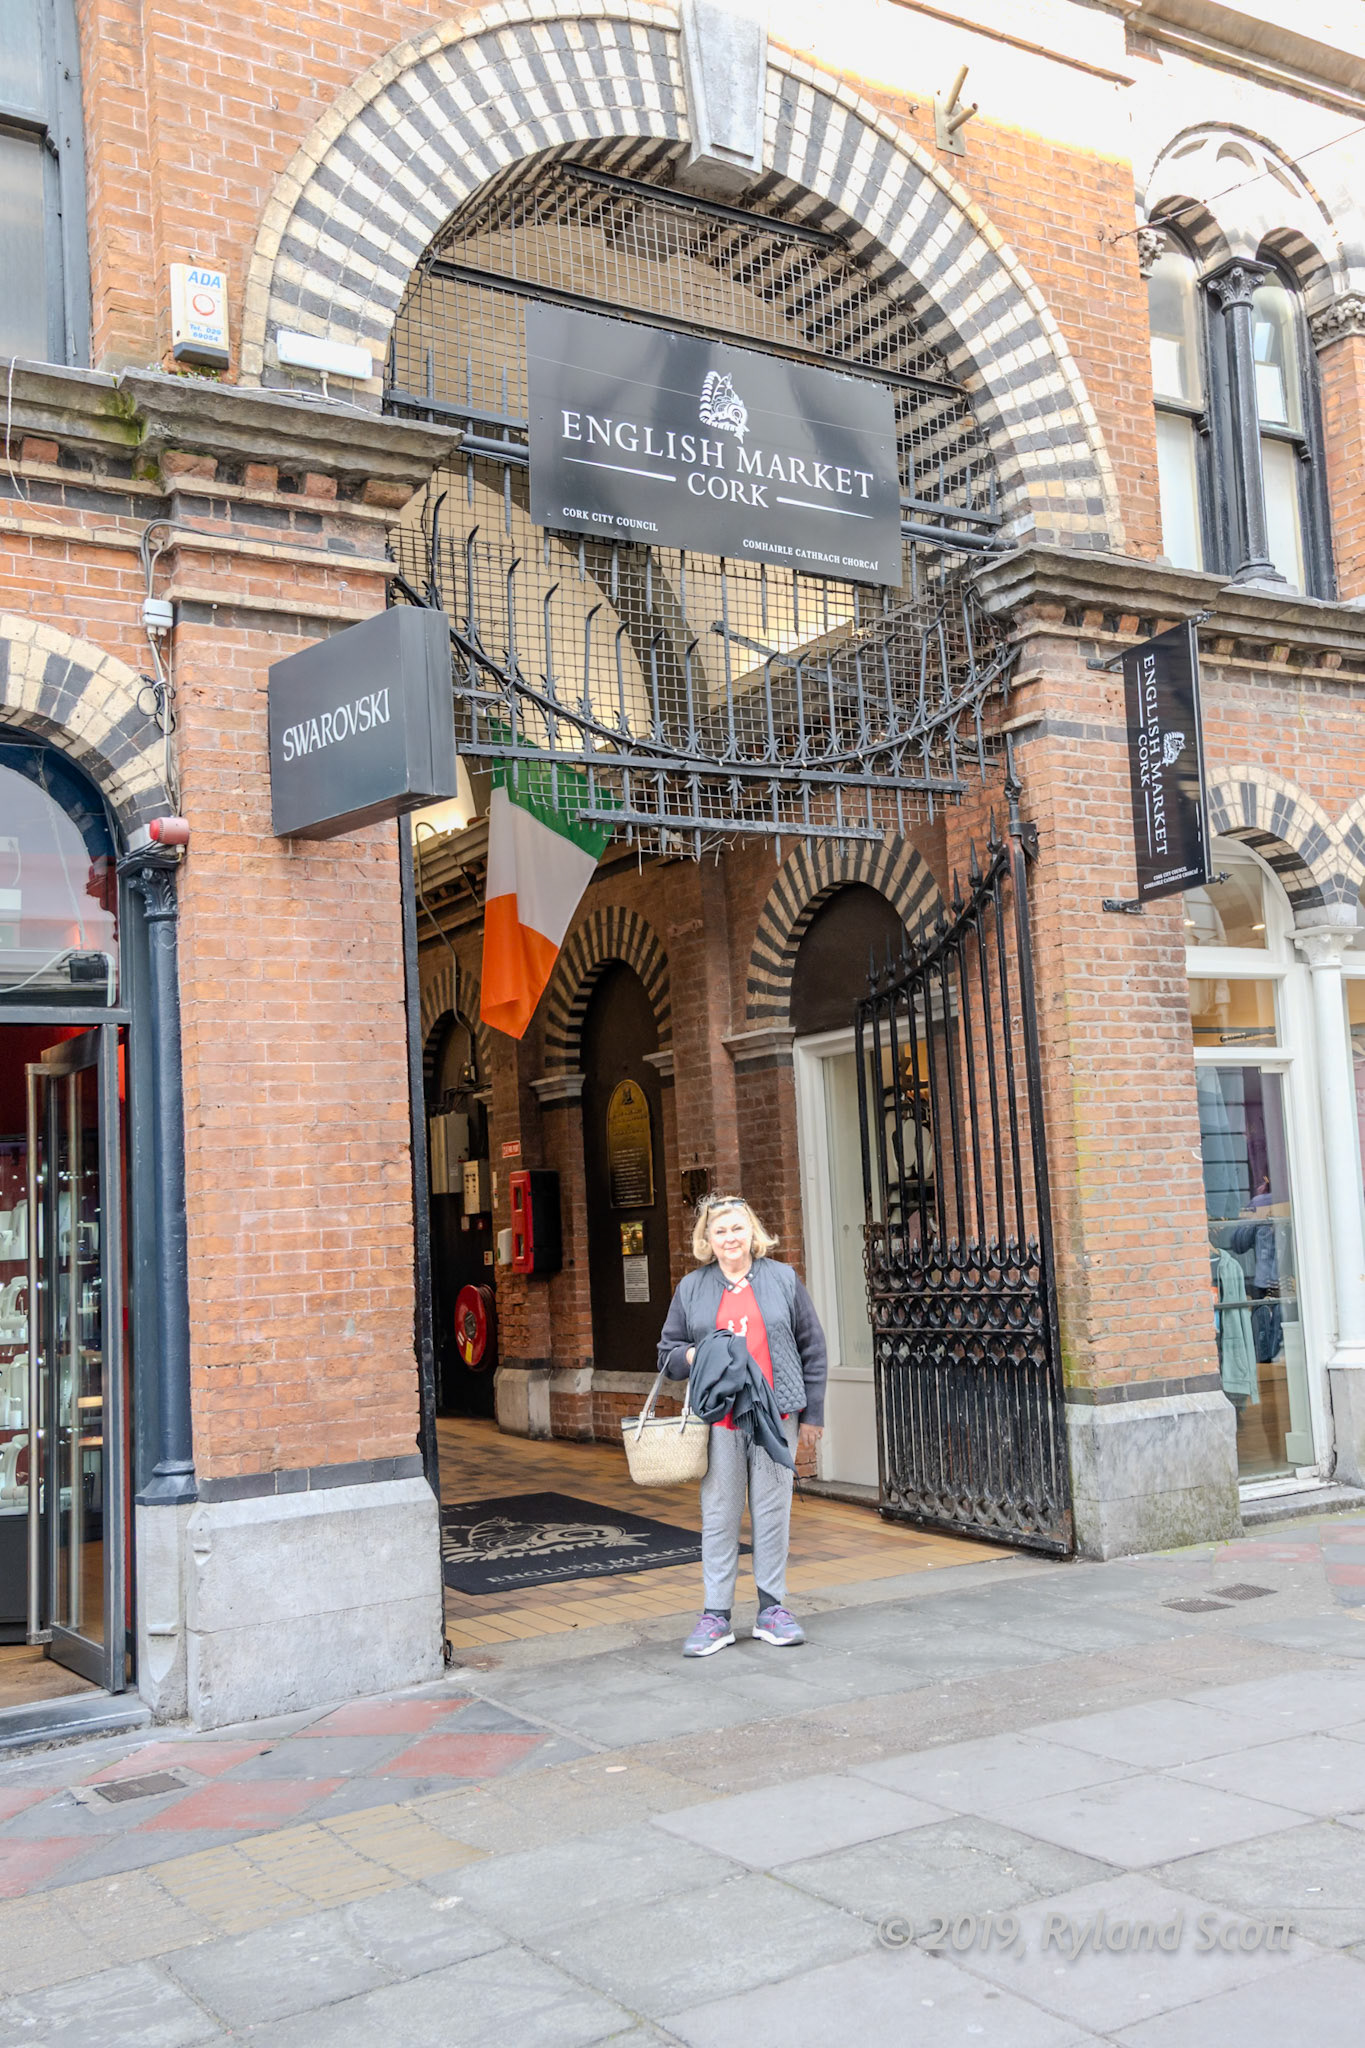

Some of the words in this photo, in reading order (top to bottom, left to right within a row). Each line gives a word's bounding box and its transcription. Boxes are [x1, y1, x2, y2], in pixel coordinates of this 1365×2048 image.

[188, 271, 222, 289] ADA
[561, 409, 725, 470] ENGLISH
[736, 446, 875, 499] MARKET
[687, 472, 770, 509] CORK
[562, 507, 590, 520] CORK
[591, 512, 614, 524] CITY
[616, 516, 659, 532] COUNCIL
[742, 539, 793, 556] COMHAIRLE
[795, 548, 841, 564] CATHRACH
[282, 687, 391, 762] SWAROVSKI
[1143, 653, 1161, 756] ENGLISH
[1138, 734, 1151, 788] CORK
[1150, 760, 1169, 855] MARKET
[486, 1562, 602, 1583] ENGLISH
